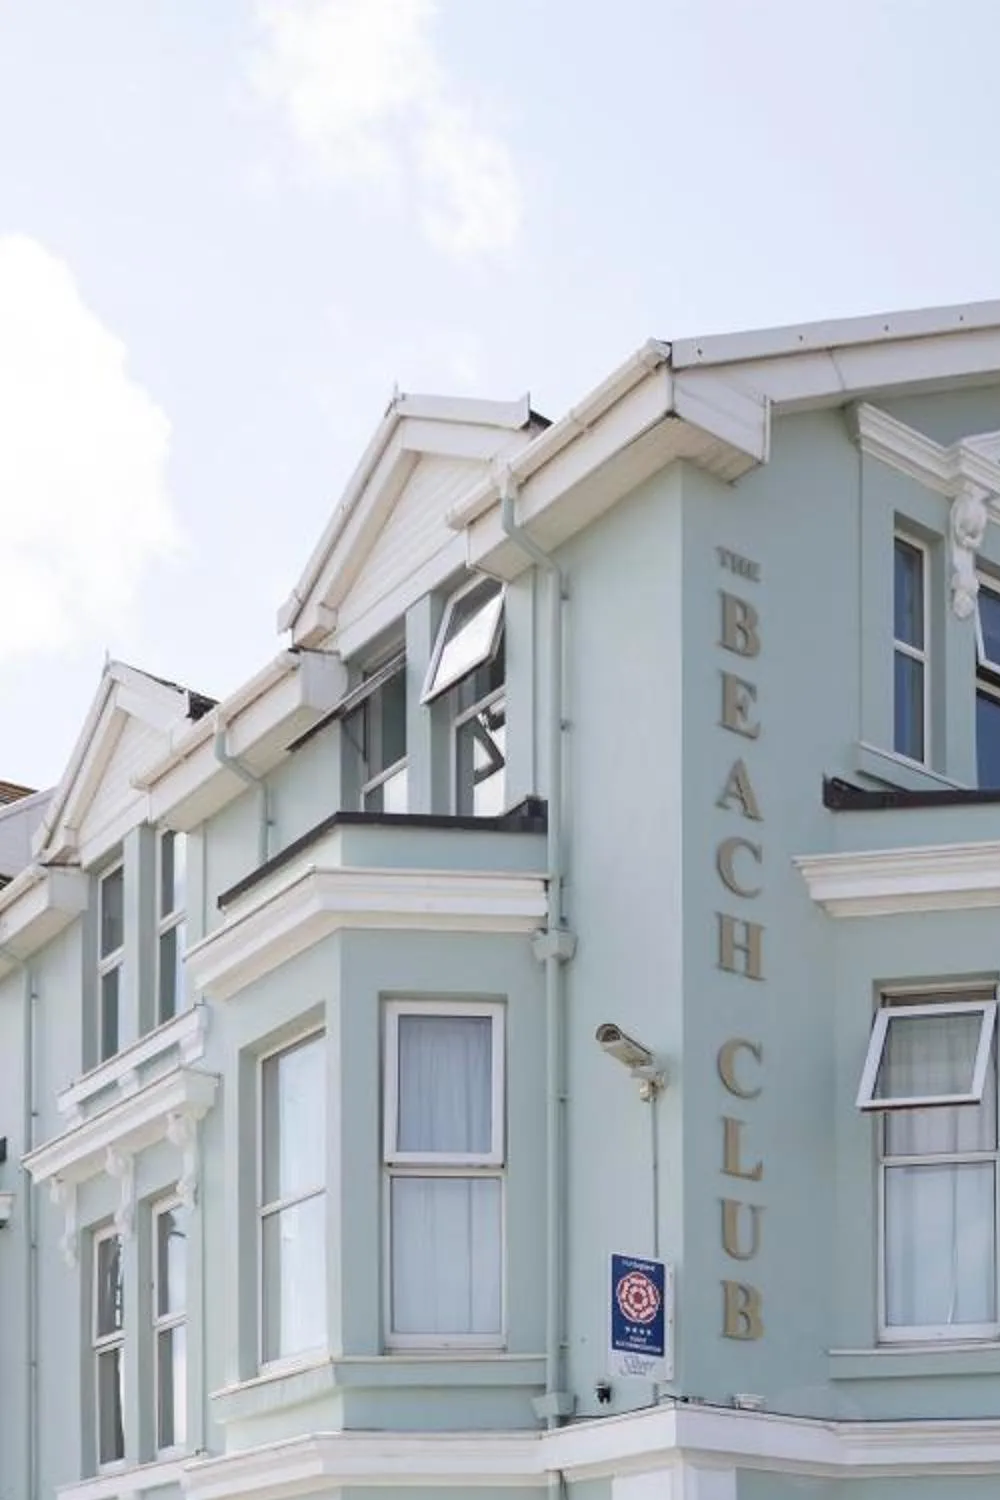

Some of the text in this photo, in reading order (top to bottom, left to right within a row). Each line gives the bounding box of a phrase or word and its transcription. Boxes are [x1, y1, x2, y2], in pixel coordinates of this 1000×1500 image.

[714, 545, 761, 584] THE
[714, 589, 767, 1341] BEACH CLUB
